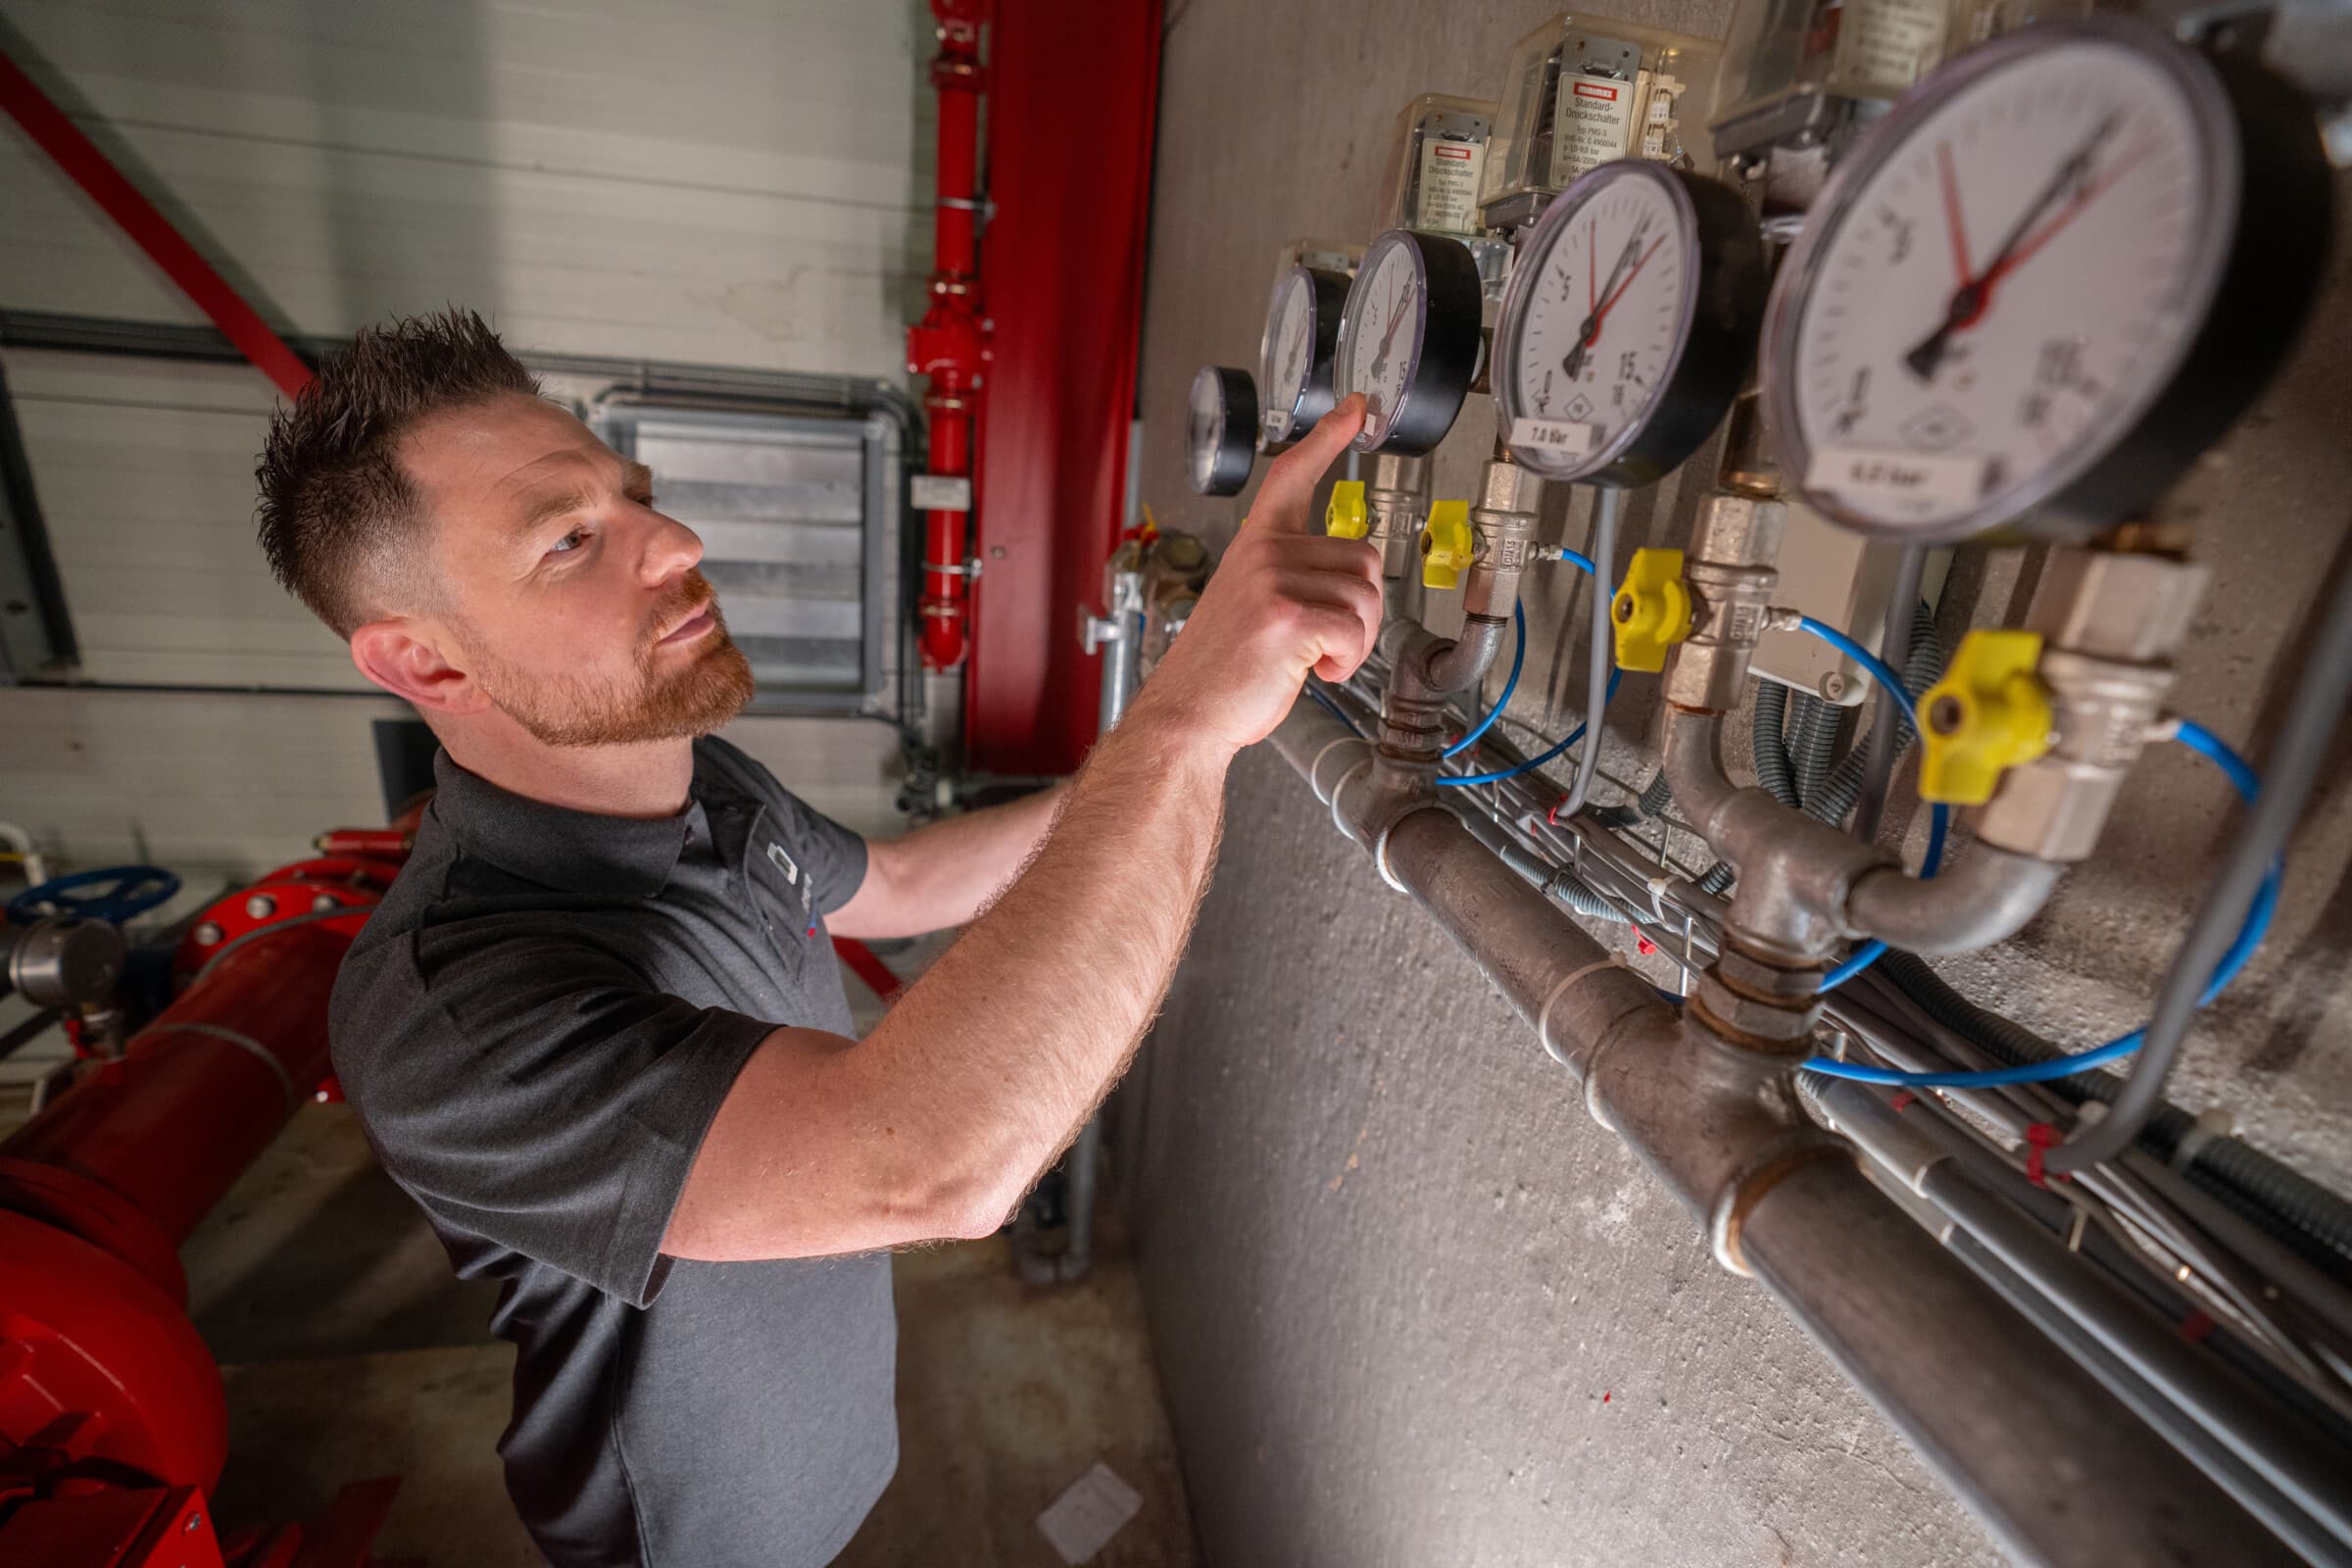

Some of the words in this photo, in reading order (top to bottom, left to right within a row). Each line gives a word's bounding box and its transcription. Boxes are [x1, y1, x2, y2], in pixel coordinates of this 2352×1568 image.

[1575, 97, 1614, 112] Standard-
[1566, 108, 1620, 124] Druckschalter
[1588, 126, 1607, 136] PMS-3
[1591, 146, 1600, 156] bar
